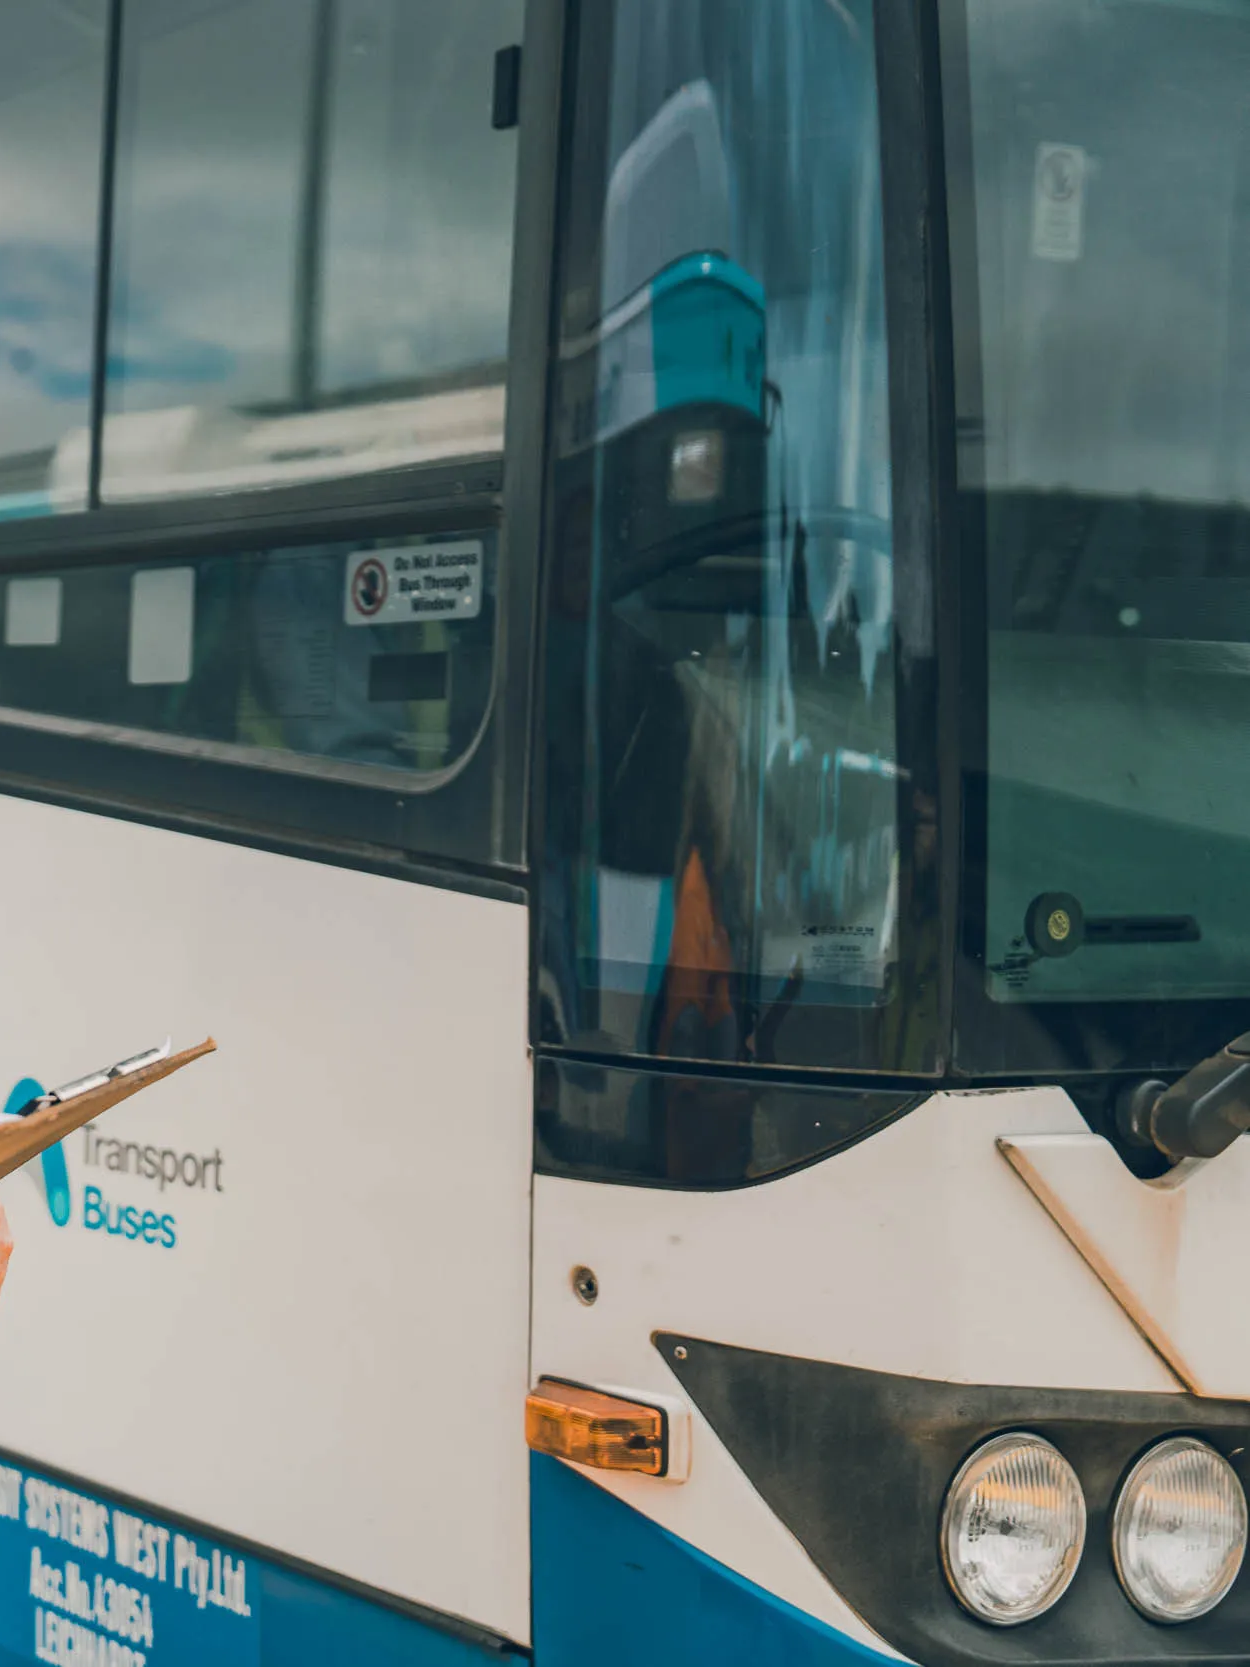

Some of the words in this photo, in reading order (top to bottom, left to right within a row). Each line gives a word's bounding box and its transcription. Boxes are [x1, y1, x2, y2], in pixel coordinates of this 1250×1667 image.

[394, 556, 409, 571] Do
[412, 554, 433, 569] Not
[435, 552, 478, 567] Access
[399, 577, 421, 592] Bus
[423, 571, 470, 592] Through
[411, 597, 456, 612] Window
[80, 1124, 224, 1192] Transport
[84, 1185, 177, 1248] Buses
[24, 1476, 109, 1559] SYSTEMS
[112, 1509, 170, 1582] WEST
